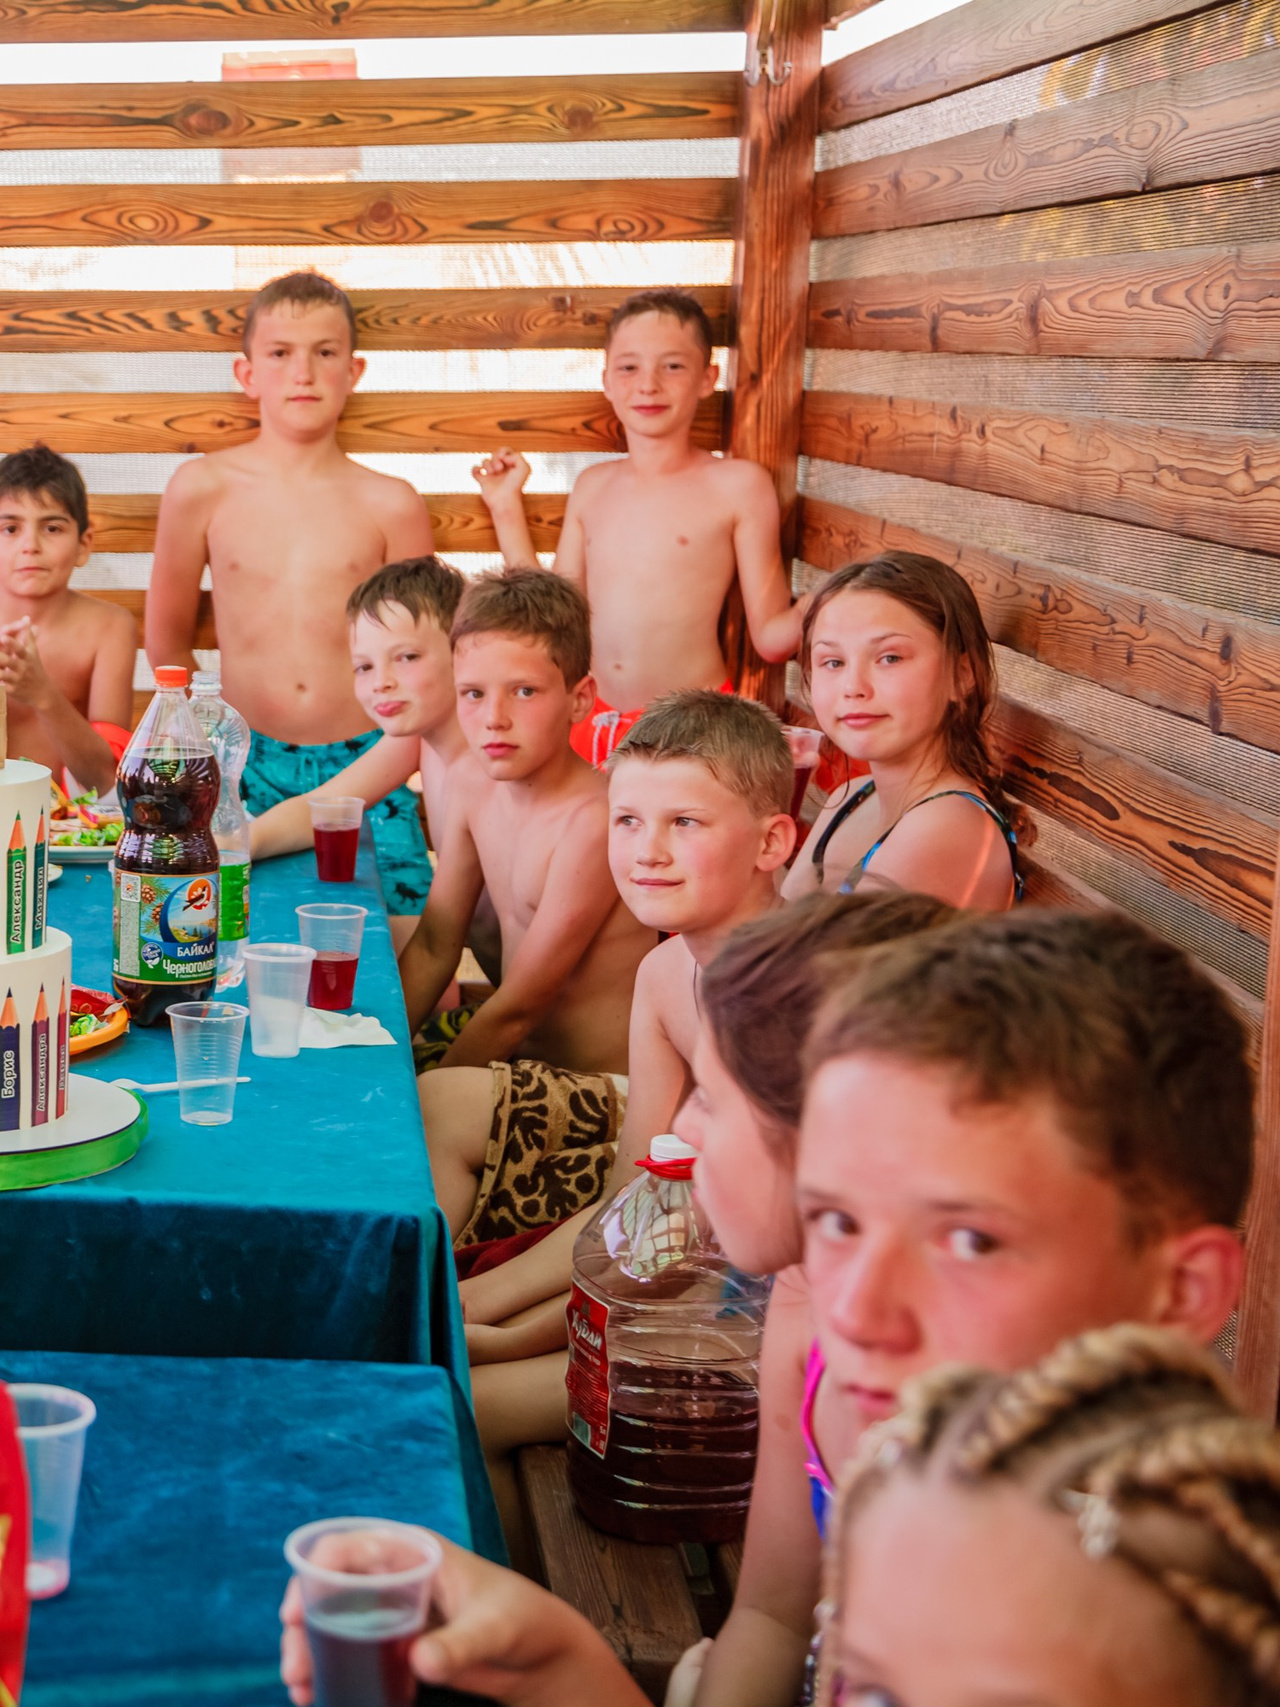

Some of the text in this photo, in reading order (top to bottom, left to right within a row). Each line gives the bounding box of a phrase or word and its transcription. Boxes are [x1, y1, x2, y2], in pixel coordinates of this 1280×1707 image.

[10, 859, 25, 944] Александр
[162, 958, 217, 978] Черноголов
[176, 943, 214, 957] БАЙКАЛ
[1, 1049, 15, 1099] Борис
[36, 1032, 48, 1112] Александра
